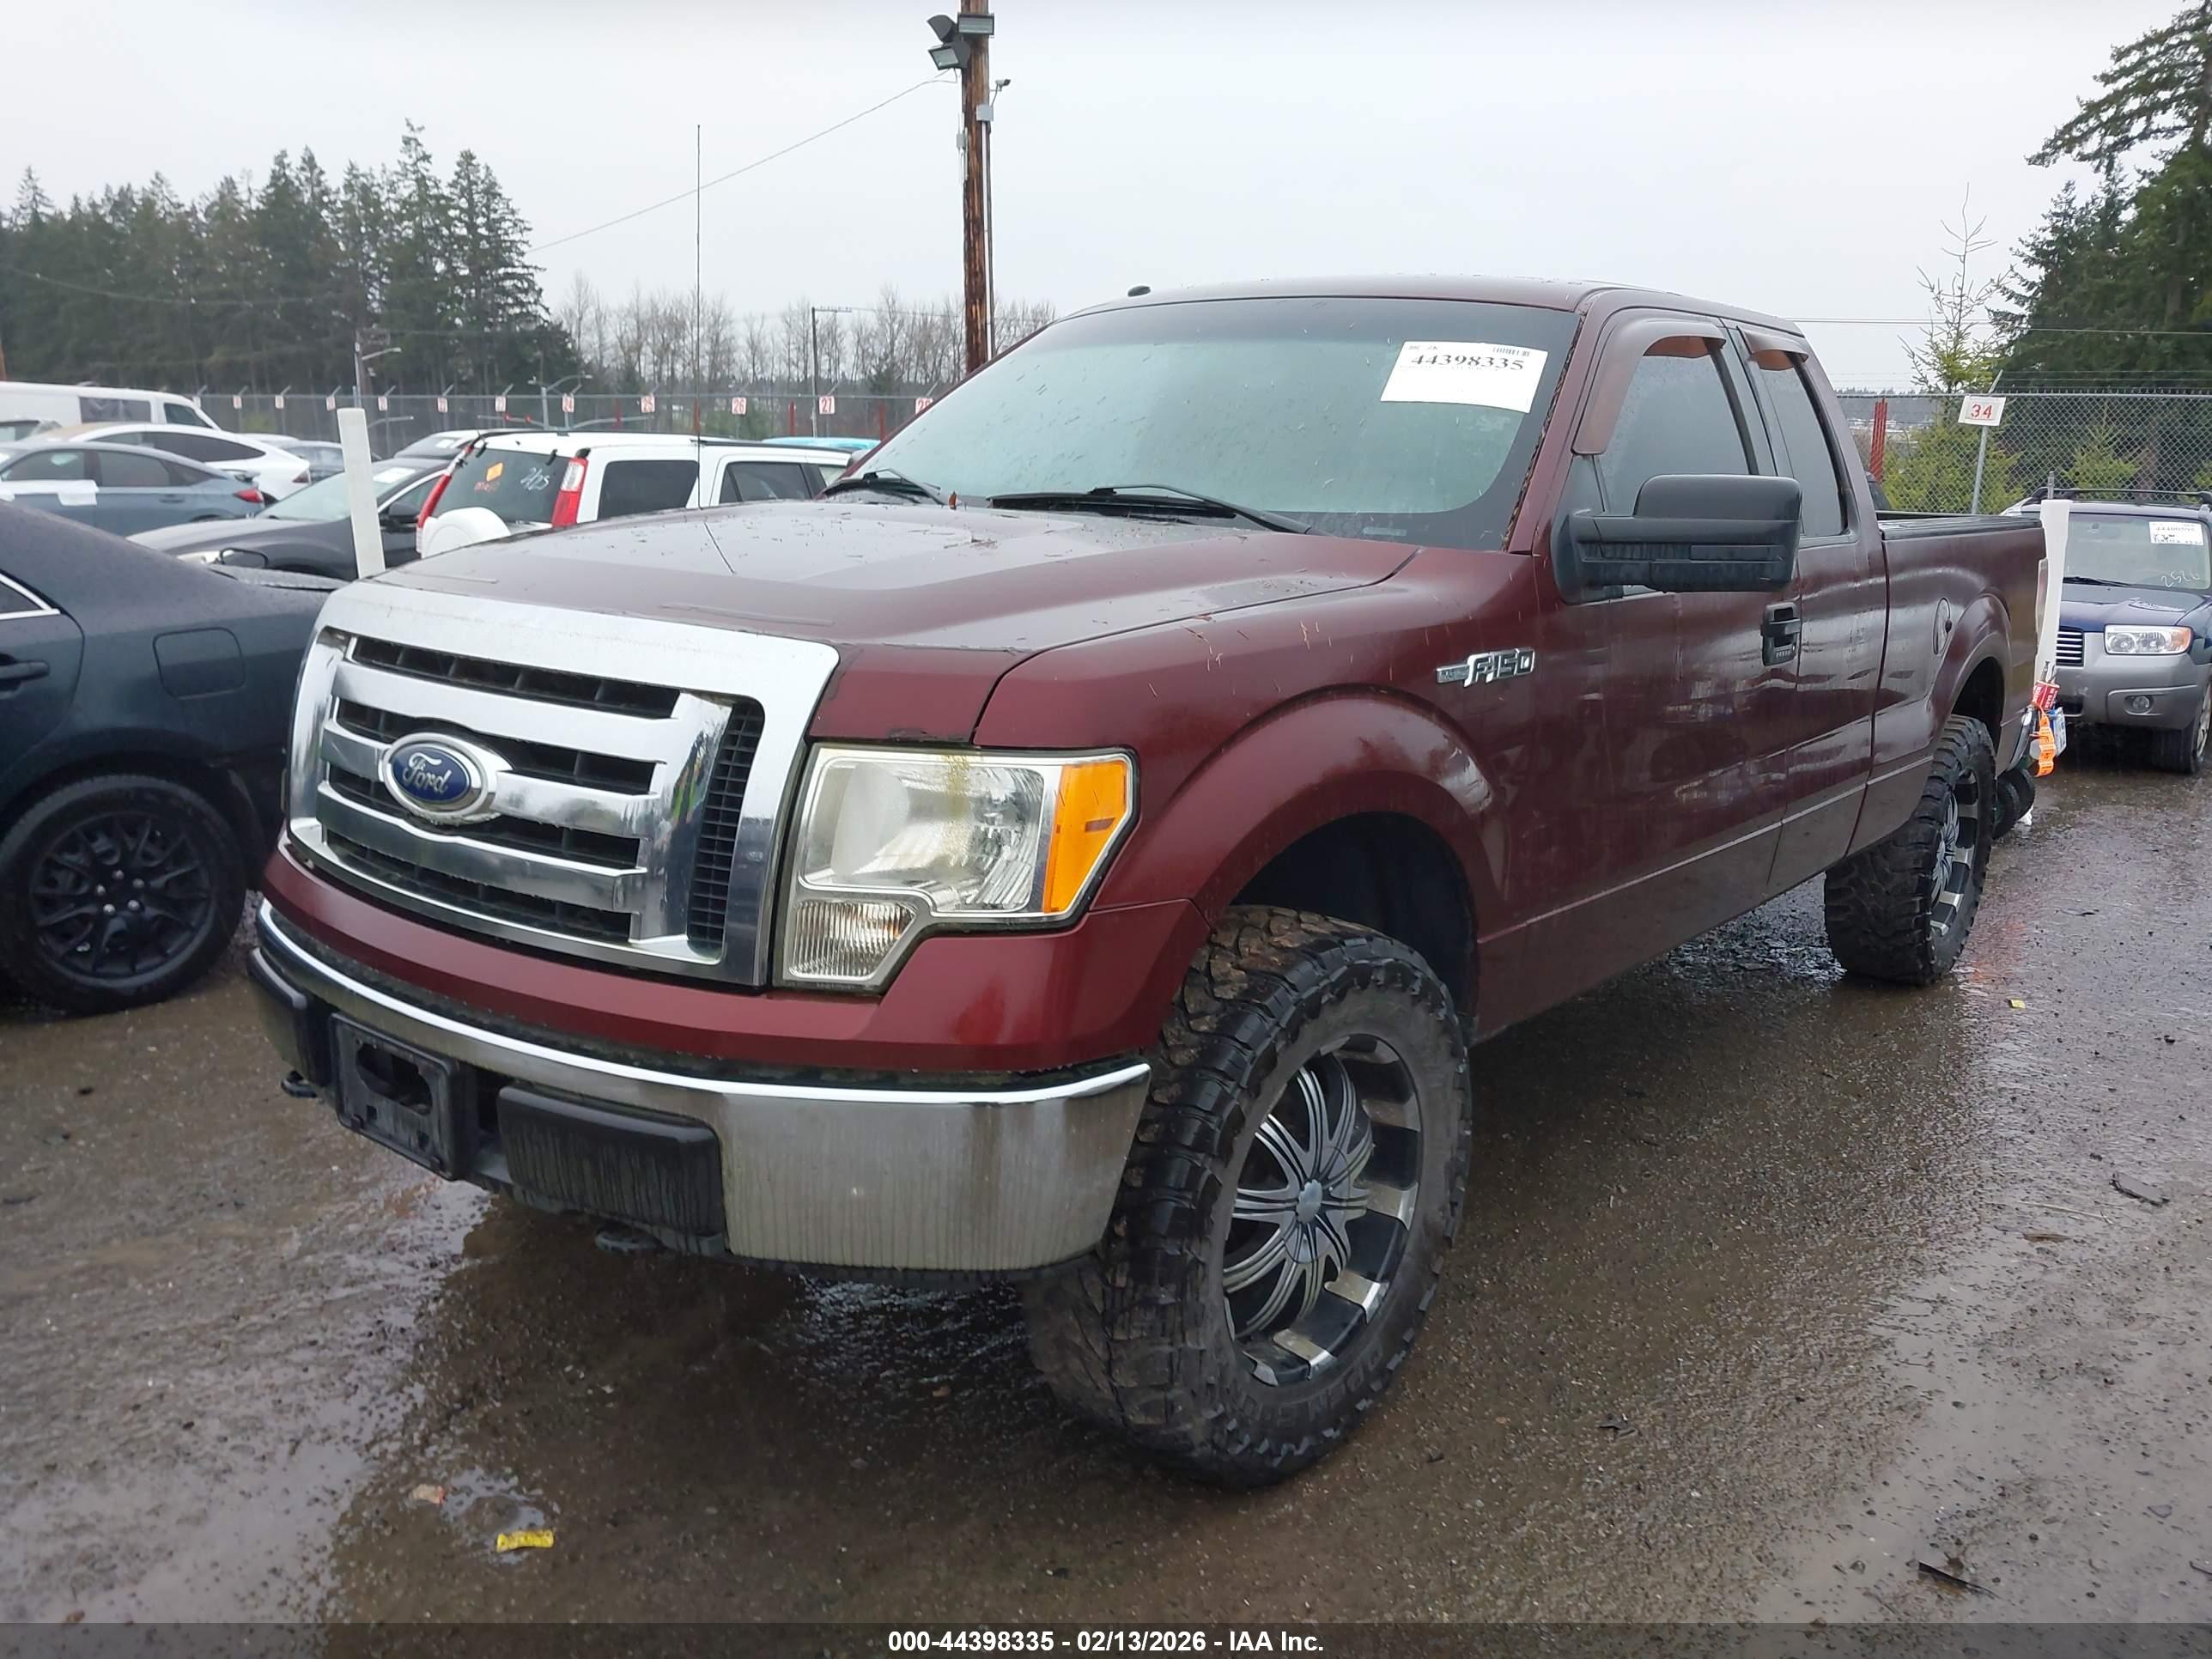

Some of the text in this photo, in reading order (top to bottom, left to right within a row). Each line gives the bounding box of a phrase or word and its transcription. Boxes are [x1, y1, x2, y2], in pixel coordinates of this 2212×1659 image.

[1411, 355, 1524, 371] 44398335
[821, 398, 832, 413] 27
[1971, 404, 1993, 419] 34
[403, 752, 452, 794] Ford
